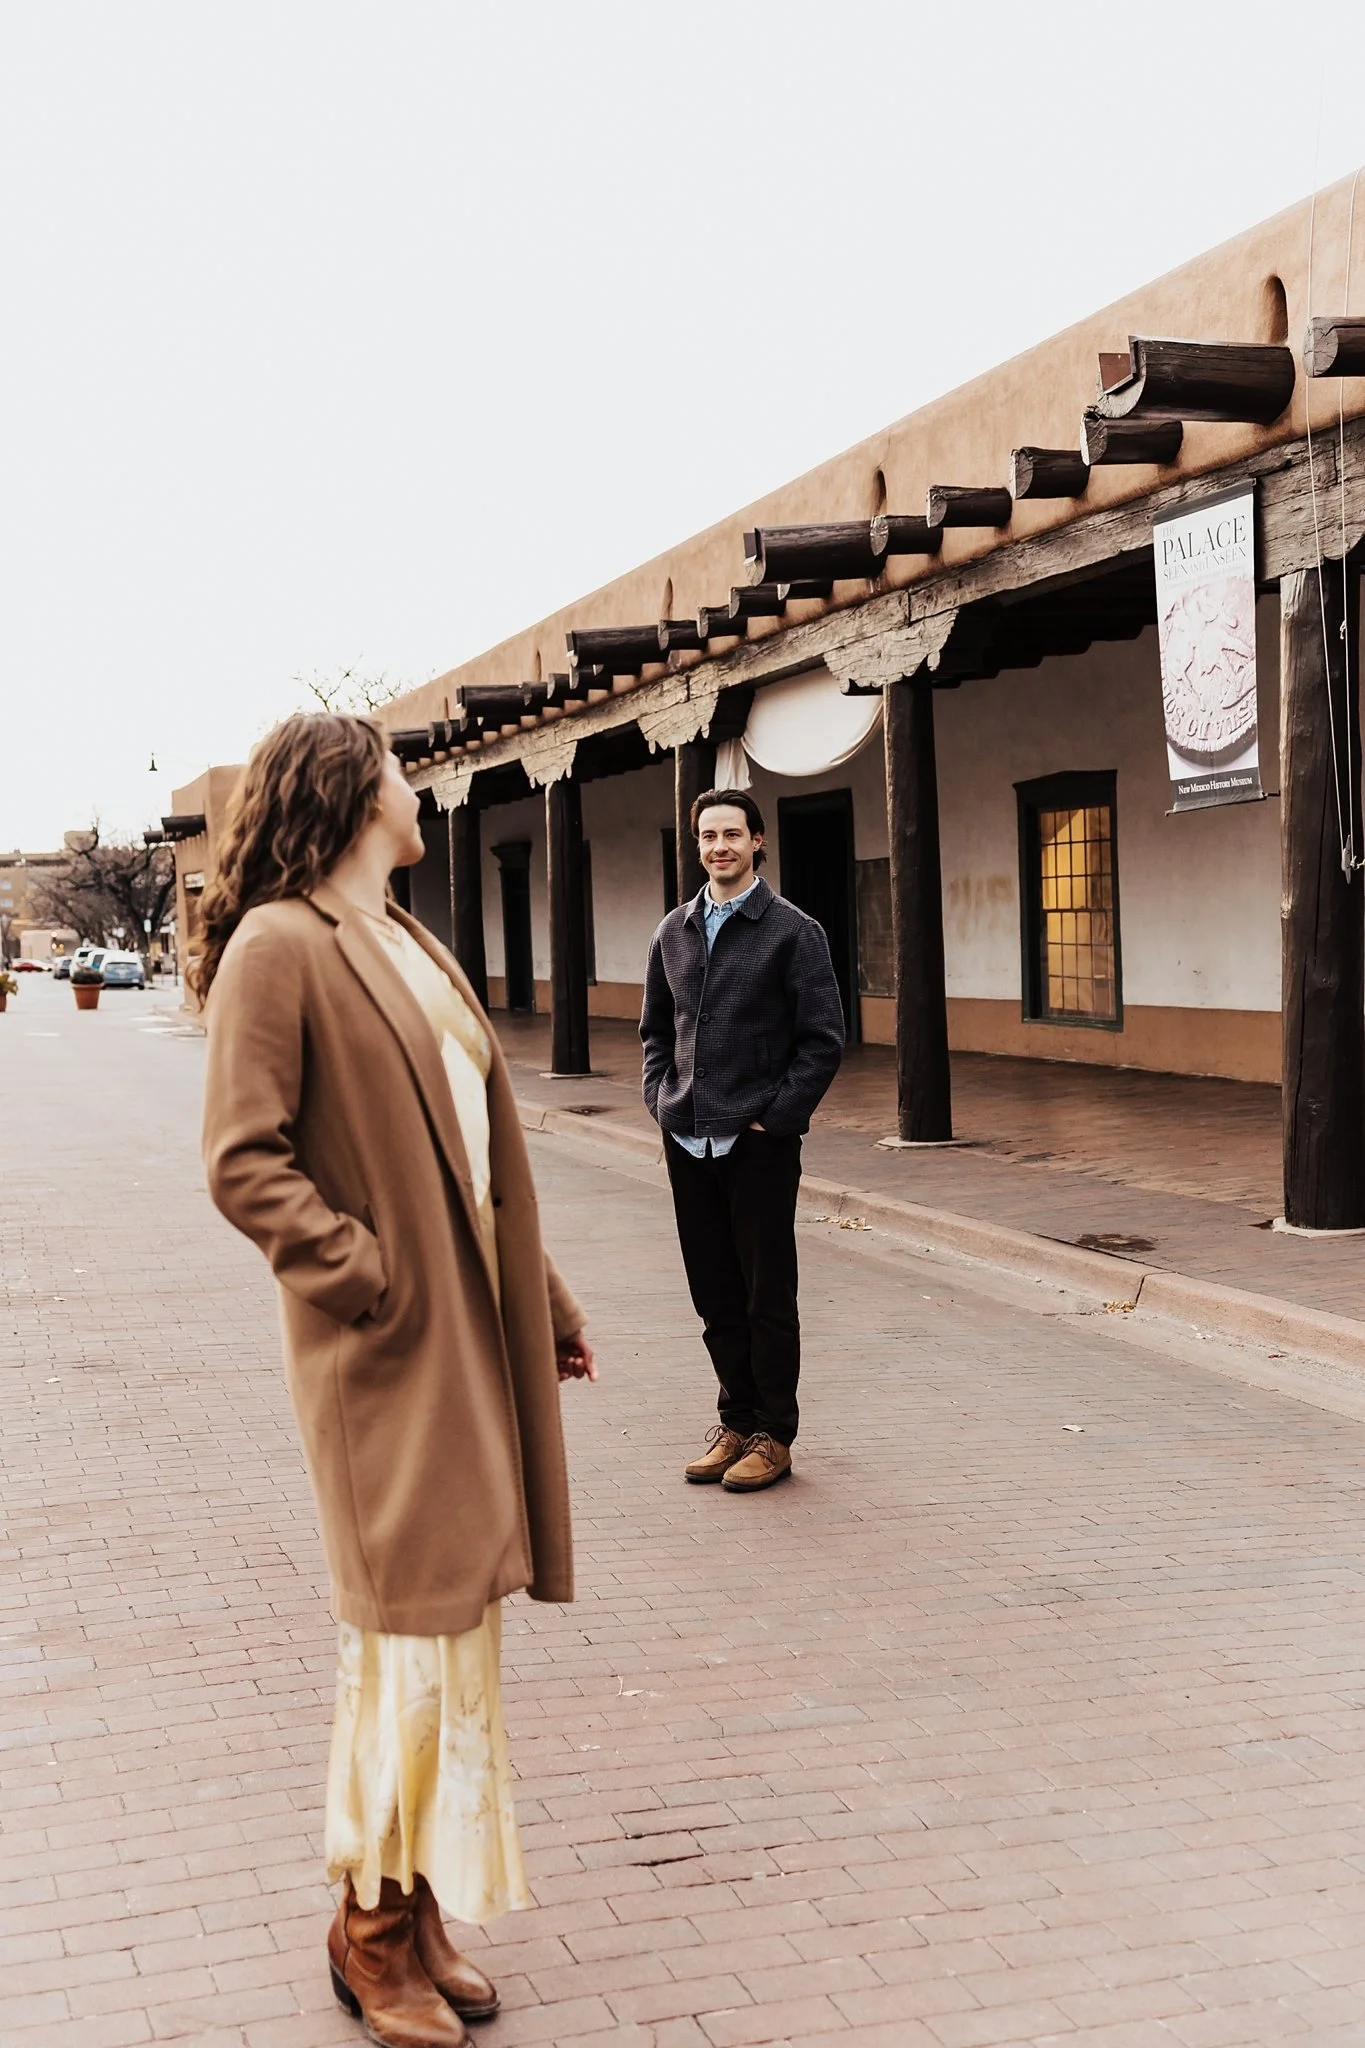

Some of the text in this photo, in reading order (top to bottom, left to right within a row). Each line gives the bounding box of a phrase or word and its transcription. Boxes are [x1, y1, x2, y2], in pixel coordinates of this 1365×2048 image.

[1163, 515, 1246, 565] PALACE
[1163, 564, 1188, 580] SEEN
[1205, 546, 1246, 568] UNSEEN
[1178, 777, 1252, 794] NEW MEXICO HISTORY MUSEUM
